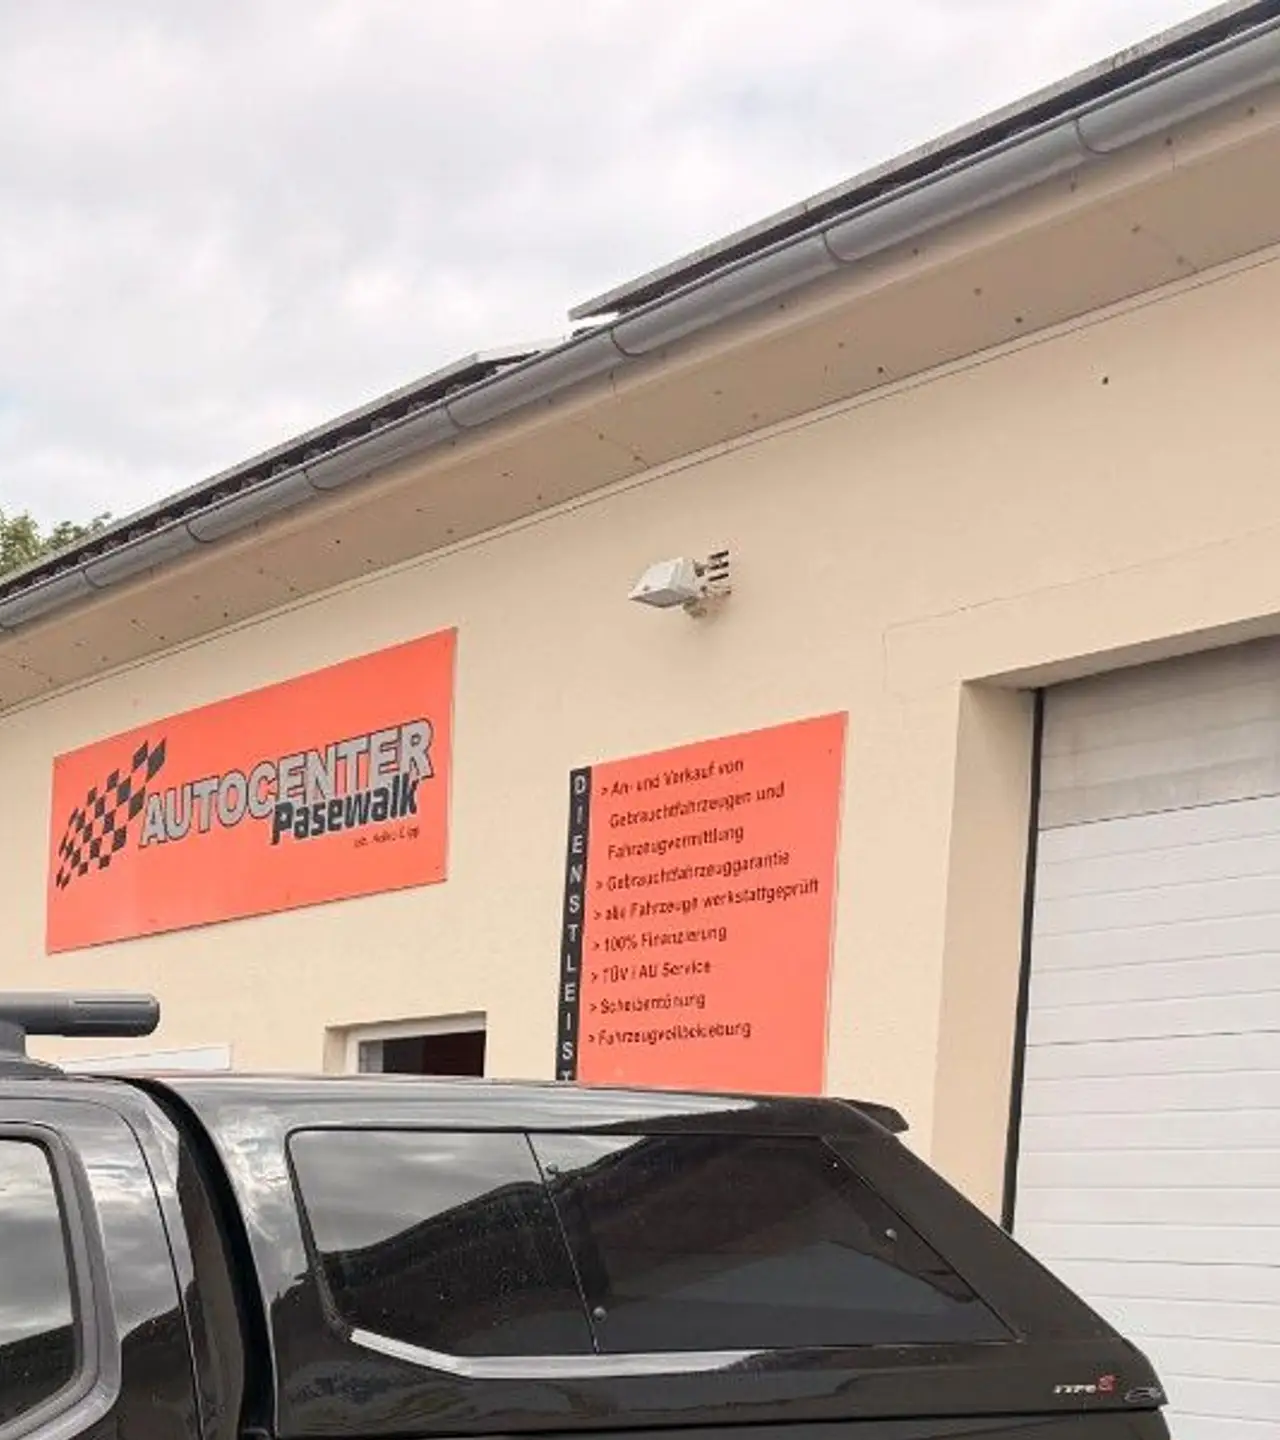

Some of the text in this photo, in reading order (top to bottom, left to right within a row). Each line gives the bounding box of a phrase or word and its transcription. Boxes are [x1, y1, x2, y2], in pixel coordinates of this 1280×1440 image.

[138, 718, 435, 850] AUTOCENTER
[637, 773, 660, 793] und
[663, 760, 715, 787] Verkauf
[718, 758, 744, 777] von
[270, 773, 420, 845] Pasewalk
[609, 781, 786, 830] Gebrauchtfahrzeugen und
[608, 825, 744, 860] Fahrzeugvermittlung
[628, 895, 699, 920] Fahrzeuge
[701, 876, 819, 910] werkstattgeprüft
[604, 926, 727, 952] 100% Finanzierung
[603, 963, 629, 983] TÜV
[639, 963, 658, 980] AU
[661, 959, 711, 979] Service
